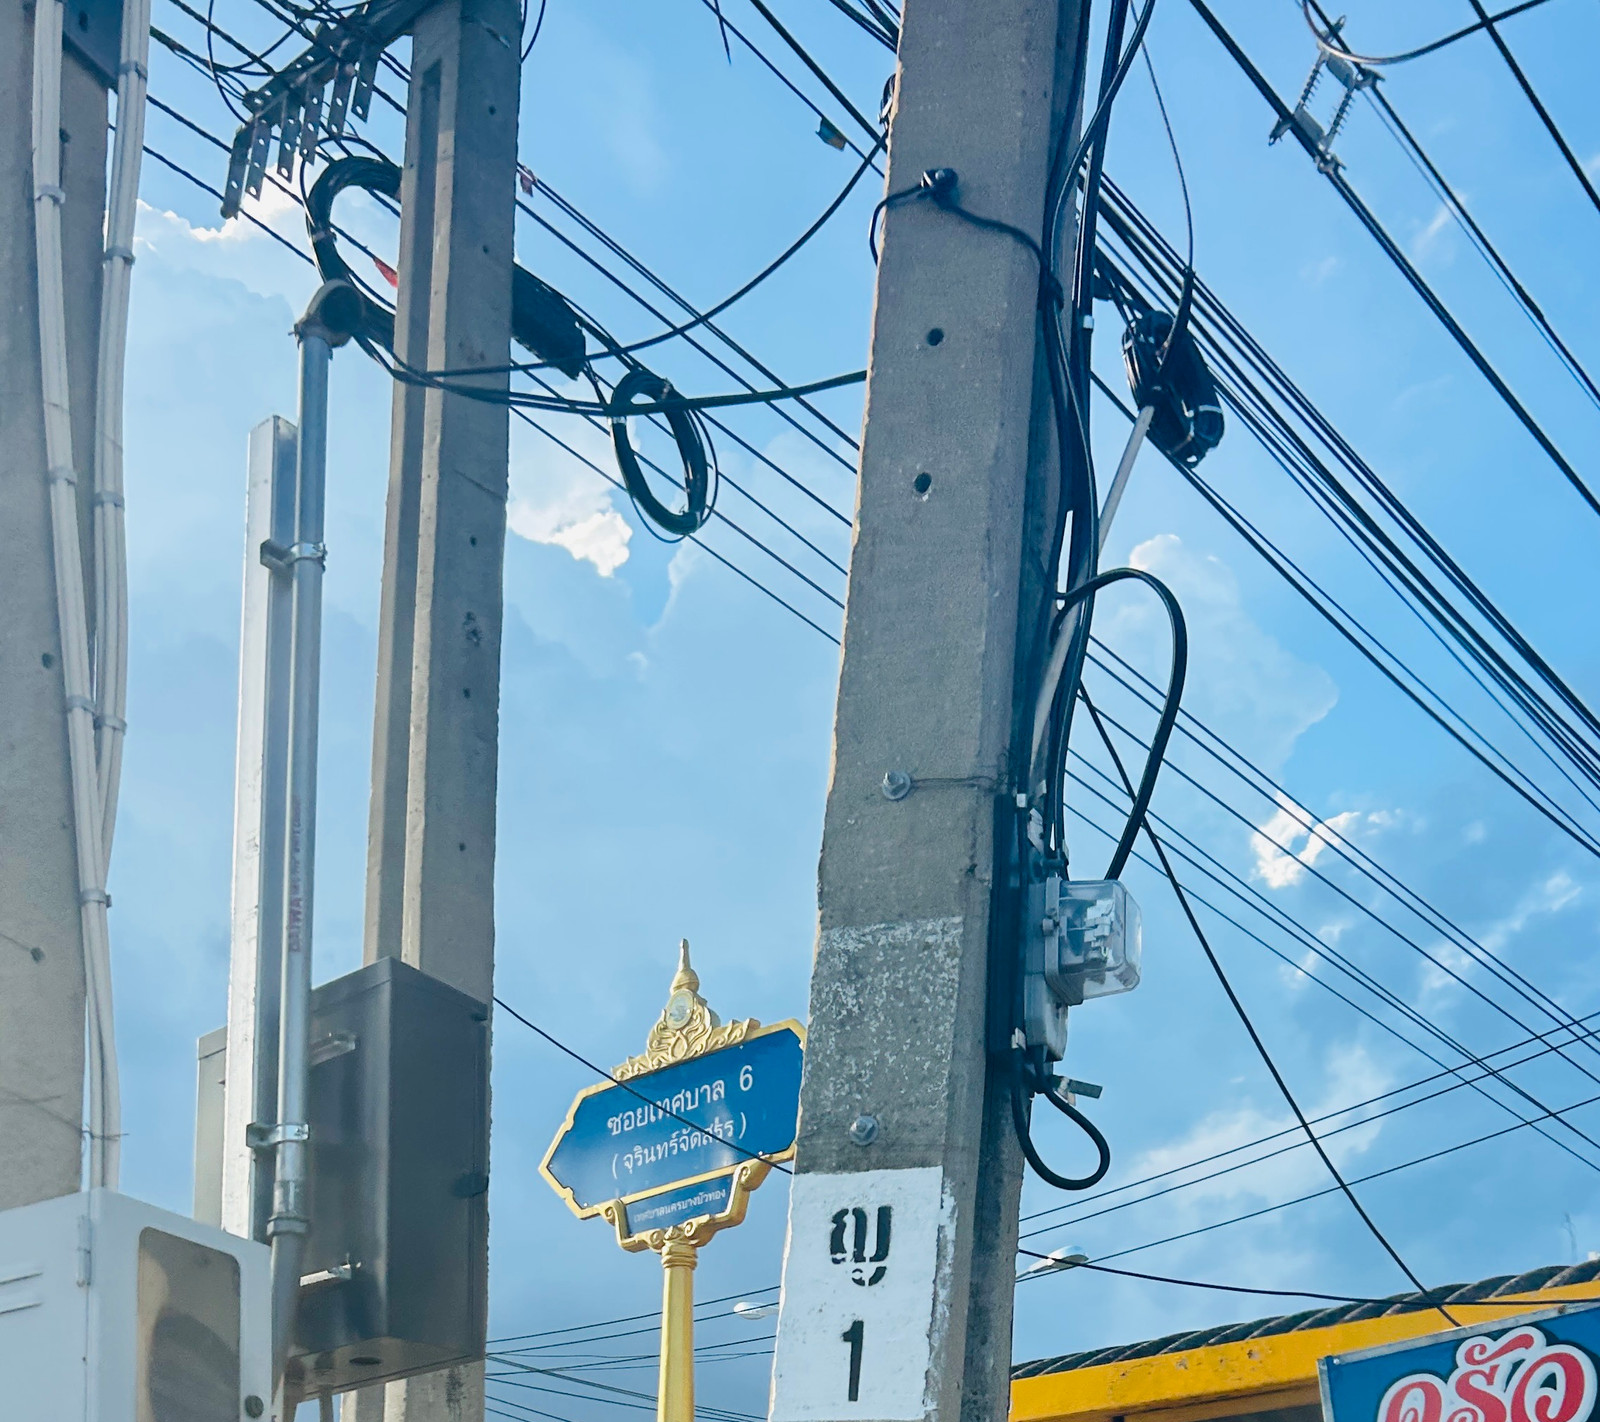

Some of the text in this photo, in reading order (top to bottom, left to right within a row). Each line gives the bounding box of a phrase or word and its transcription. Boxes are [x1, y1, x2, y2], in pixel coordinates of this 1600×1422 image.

[607, 1064, 754, 1136] ซอยเทศบาล 6
[829, 1205, 893, 1287] ญ
[841, 1319, 865, 1402] 1
